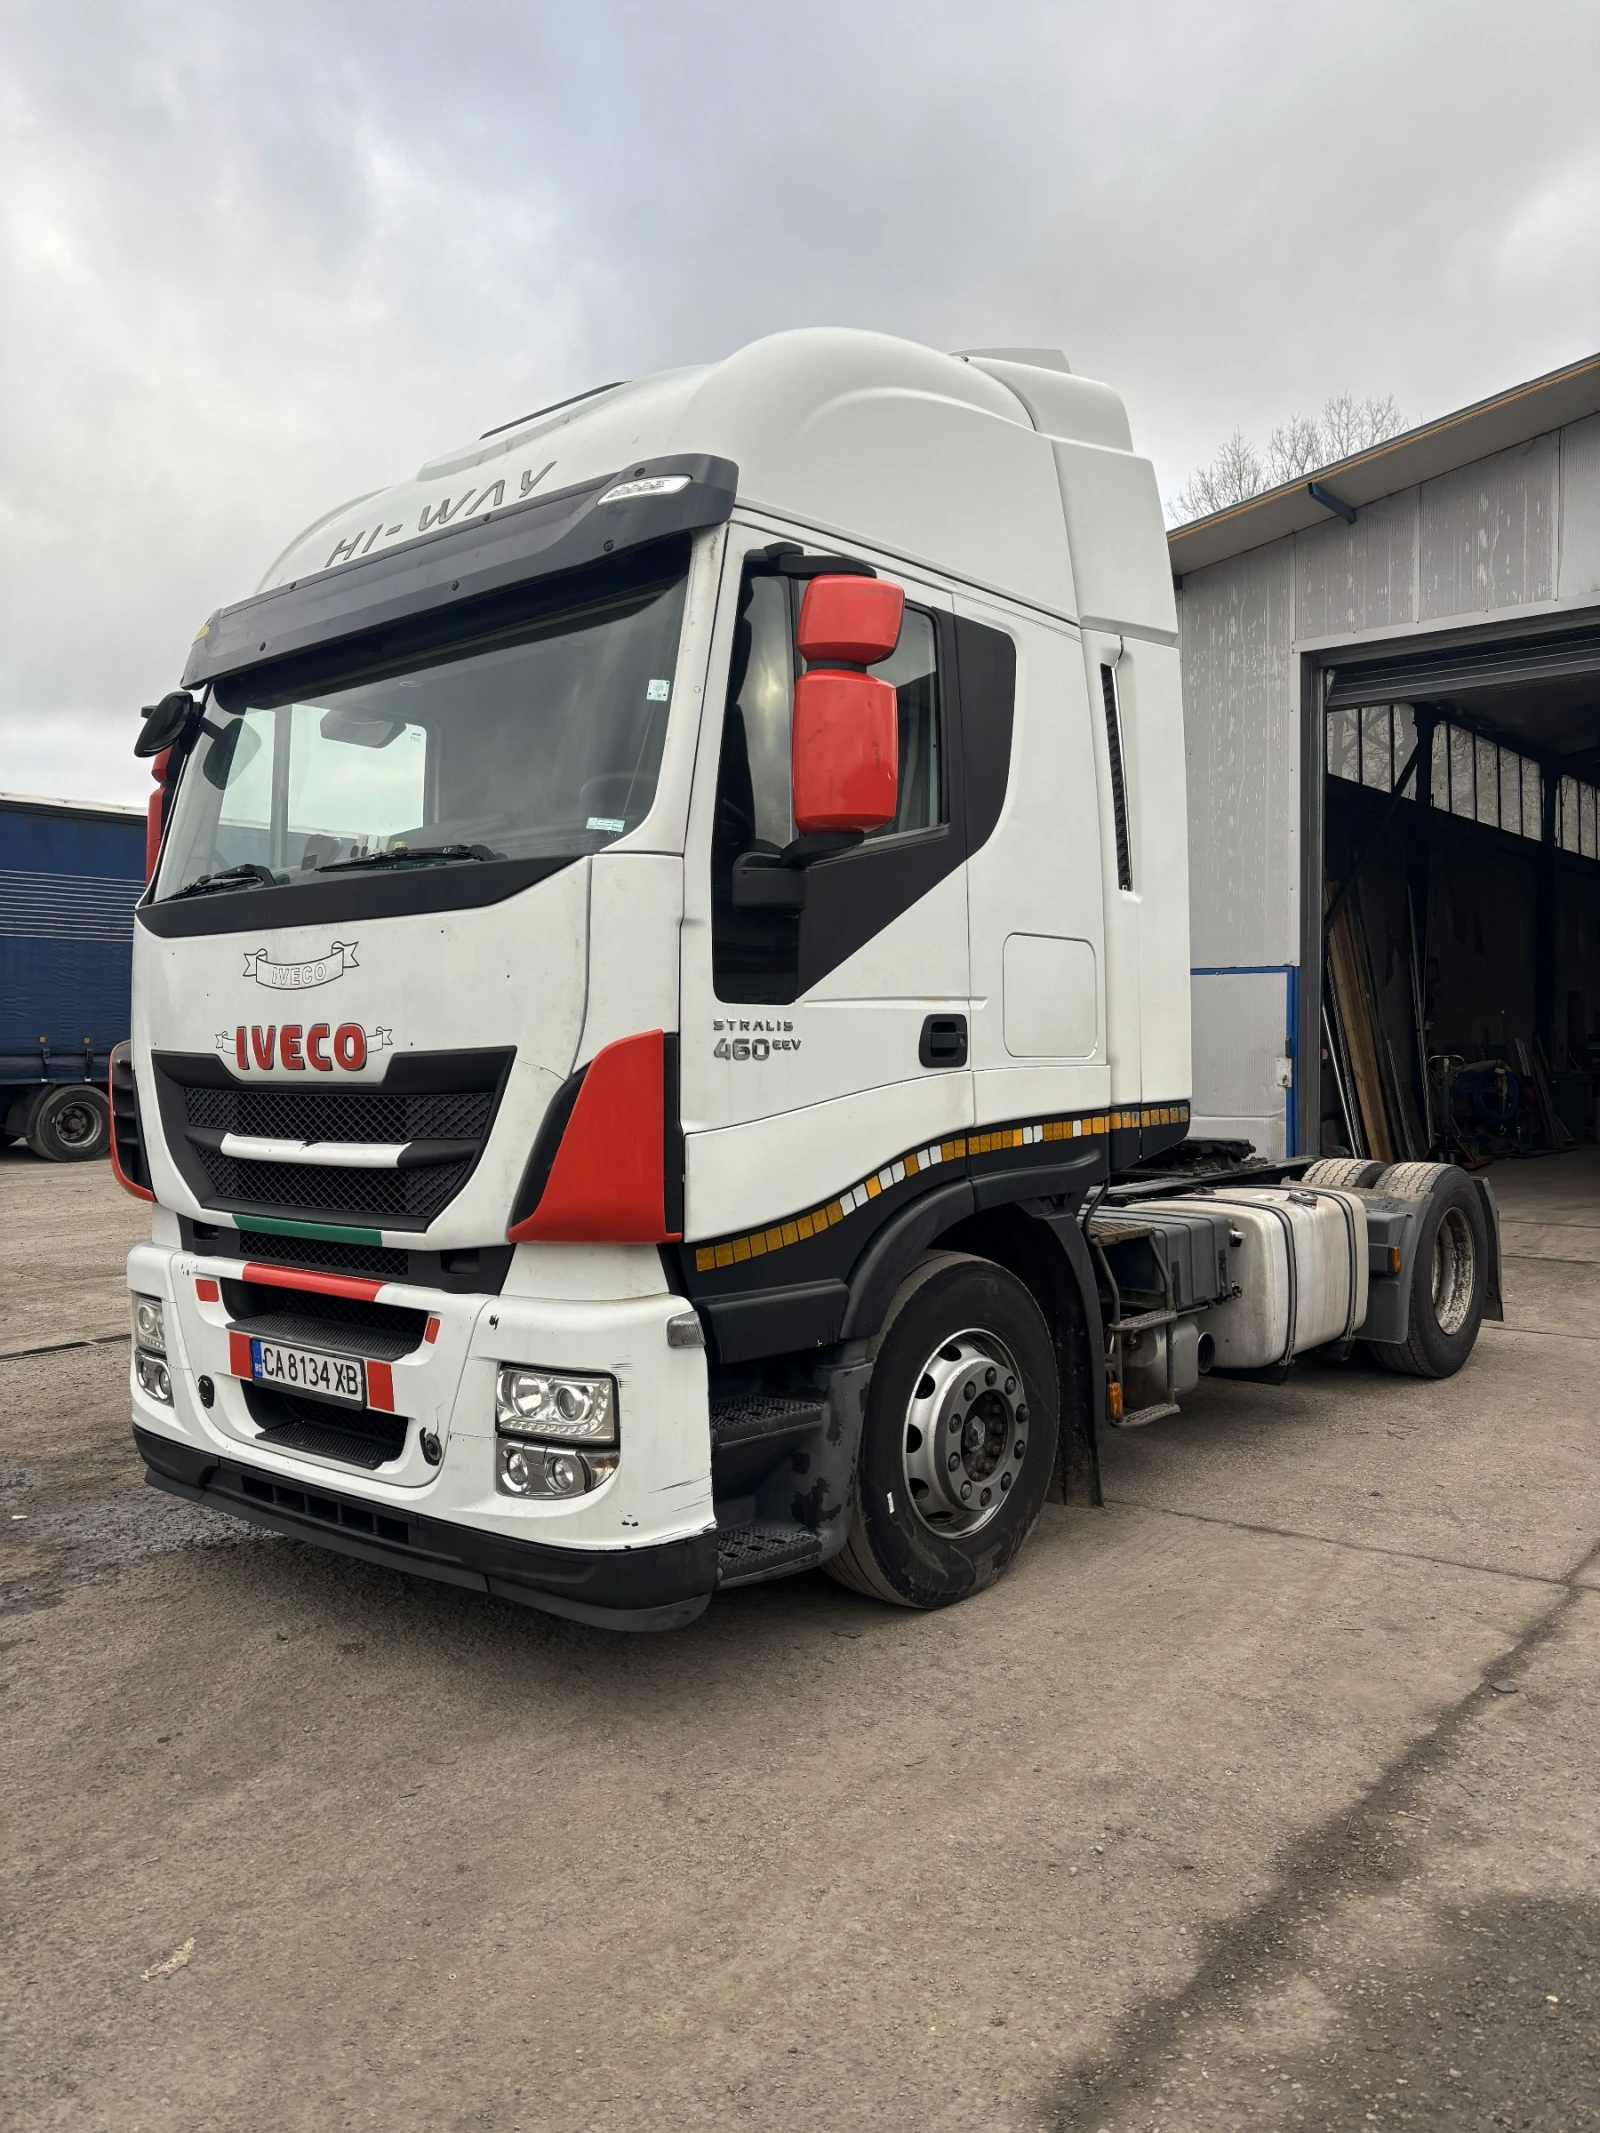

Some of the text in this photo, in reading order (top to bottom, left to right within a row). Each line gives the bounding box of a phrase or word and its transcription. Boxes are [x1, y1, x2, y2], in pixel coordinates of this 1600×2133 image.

[271, 962, 327, 986] IVECO
[713, 1018, 794, 1032] STRALIS
[235, 1022, 368, 1072] IVECO
[713, 1037, 802, 1061] 460 EEV
